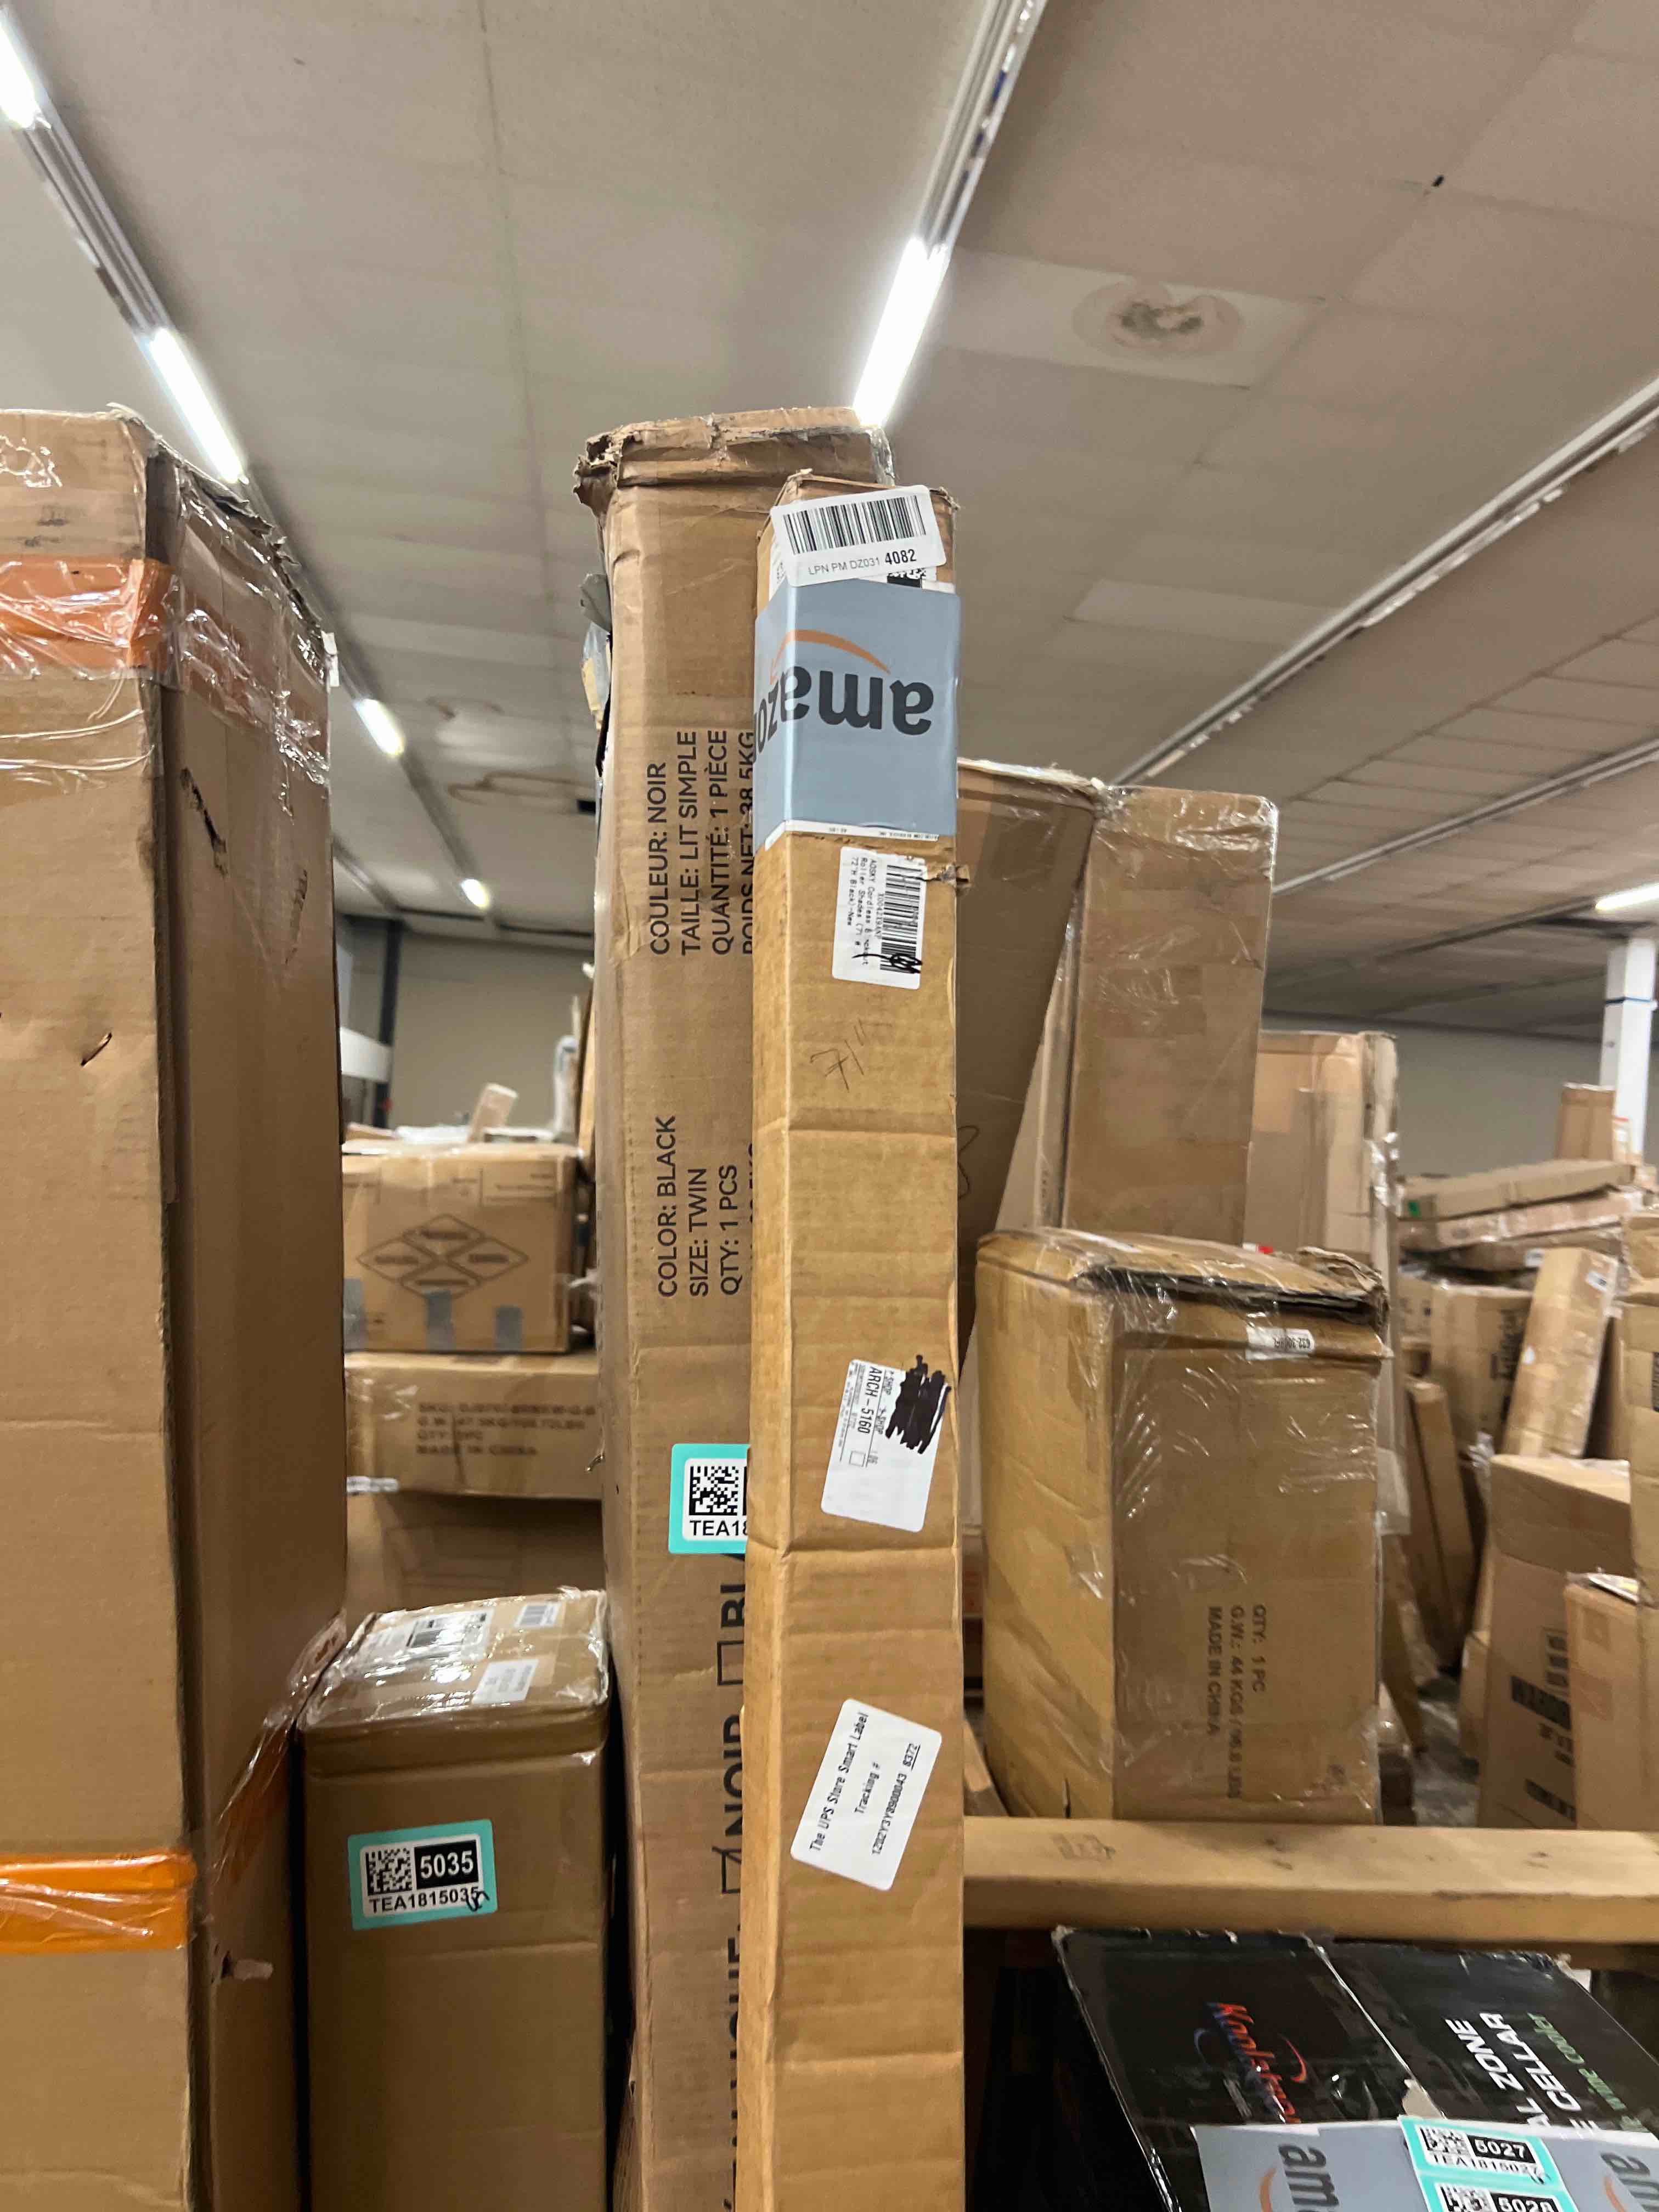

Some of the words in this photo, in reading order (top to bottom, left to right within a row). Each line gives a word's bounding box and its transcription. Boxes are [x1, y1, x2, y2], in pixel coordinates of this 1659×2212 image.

[809, 562, 830, 575] LPN
[832, 561, 848, 571] PM
[850, 557, 880, 568] DZ031
[885, 549, 917, 565] 4082
[754, 665, 934, 763] amazo
[677, 731, 698, 819] SIMPLE
[704, 730, 728, 798] PIÈCE
[738, 731, 755, 816] 385KG
[647, 763, 667, 823] NOIR
[711, 808, 729, 817] 1
[679, 825, 698, 860] LIT
[648, 832, 670, 955] COULEUR:
[706, 826, 734, 955] QUANTITÉ:
[859, 857, 868, 885] Roller
[680, 868, 701, 956] TAILLE:
[865, 886, 874, 923] Cordless
[656, 1115, 676, 1197] BLACK
[687, 1169, 708, 1232] TWIN
[719, 1165, 737, 1210] PCS
[658, 1205, 677, 1296] COLOR:
[719, 1221, 738, 1231] 1
[690, 1240, 708, 1296] SIZE:
[720, 1240, 742, 1295] QTY:
[865, 1366, 882, 1397] ARCH
[857, 1407, 873, 1435] 5160
[1208, 1606, 1221, 1654] MADE
[1208, 1659, 1221, 1676] IN
[1252, 1668, 1265, 1692] PC
[1207, 1681, 1221, 1736] CHINA
[809, 1831, 825, 1853] The
[818, 1805, 834, 1830] UPS
[827, 1775, 846, 1805] Store
[837, 1741, 858, 1774] Smart
[849, 1711, 868, 1741] Label
[854, 1770, 880, 1815] Tracking
[420, 1850, 473, 1878] 5035
[1444, 2018, 1524, 2091] ZONE
[1480, 2012, 1582, 2112] CELLAR
[1475, 2139, 1526, 2159] 5027
